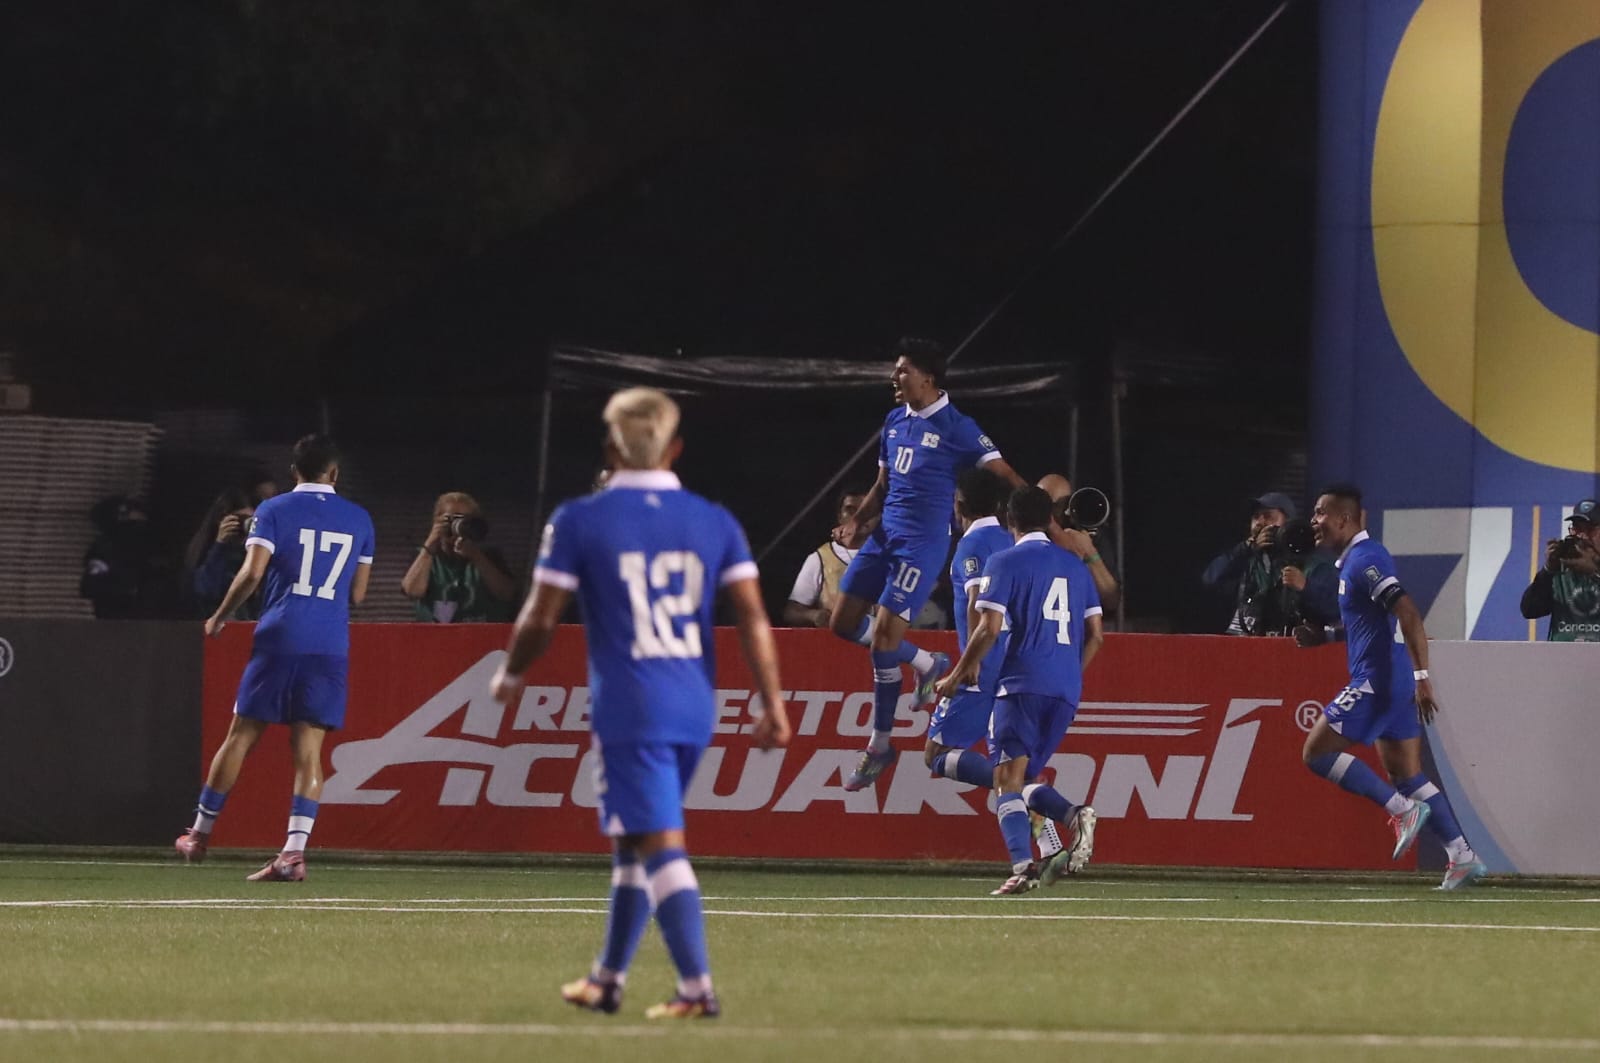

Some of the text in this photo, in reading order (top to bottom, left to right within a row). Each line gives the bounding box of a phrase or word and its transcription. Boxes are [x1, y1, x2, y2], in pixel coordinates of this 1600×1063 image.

[895, 446, 914, 474] 10
[921, 432, 940, 448] ES
[292, 529, 353, 600] 17
[892, 562, 921, 593] 10
[618, 551, 705, 661] 12
[1042, 577, 1072, 645] 4
